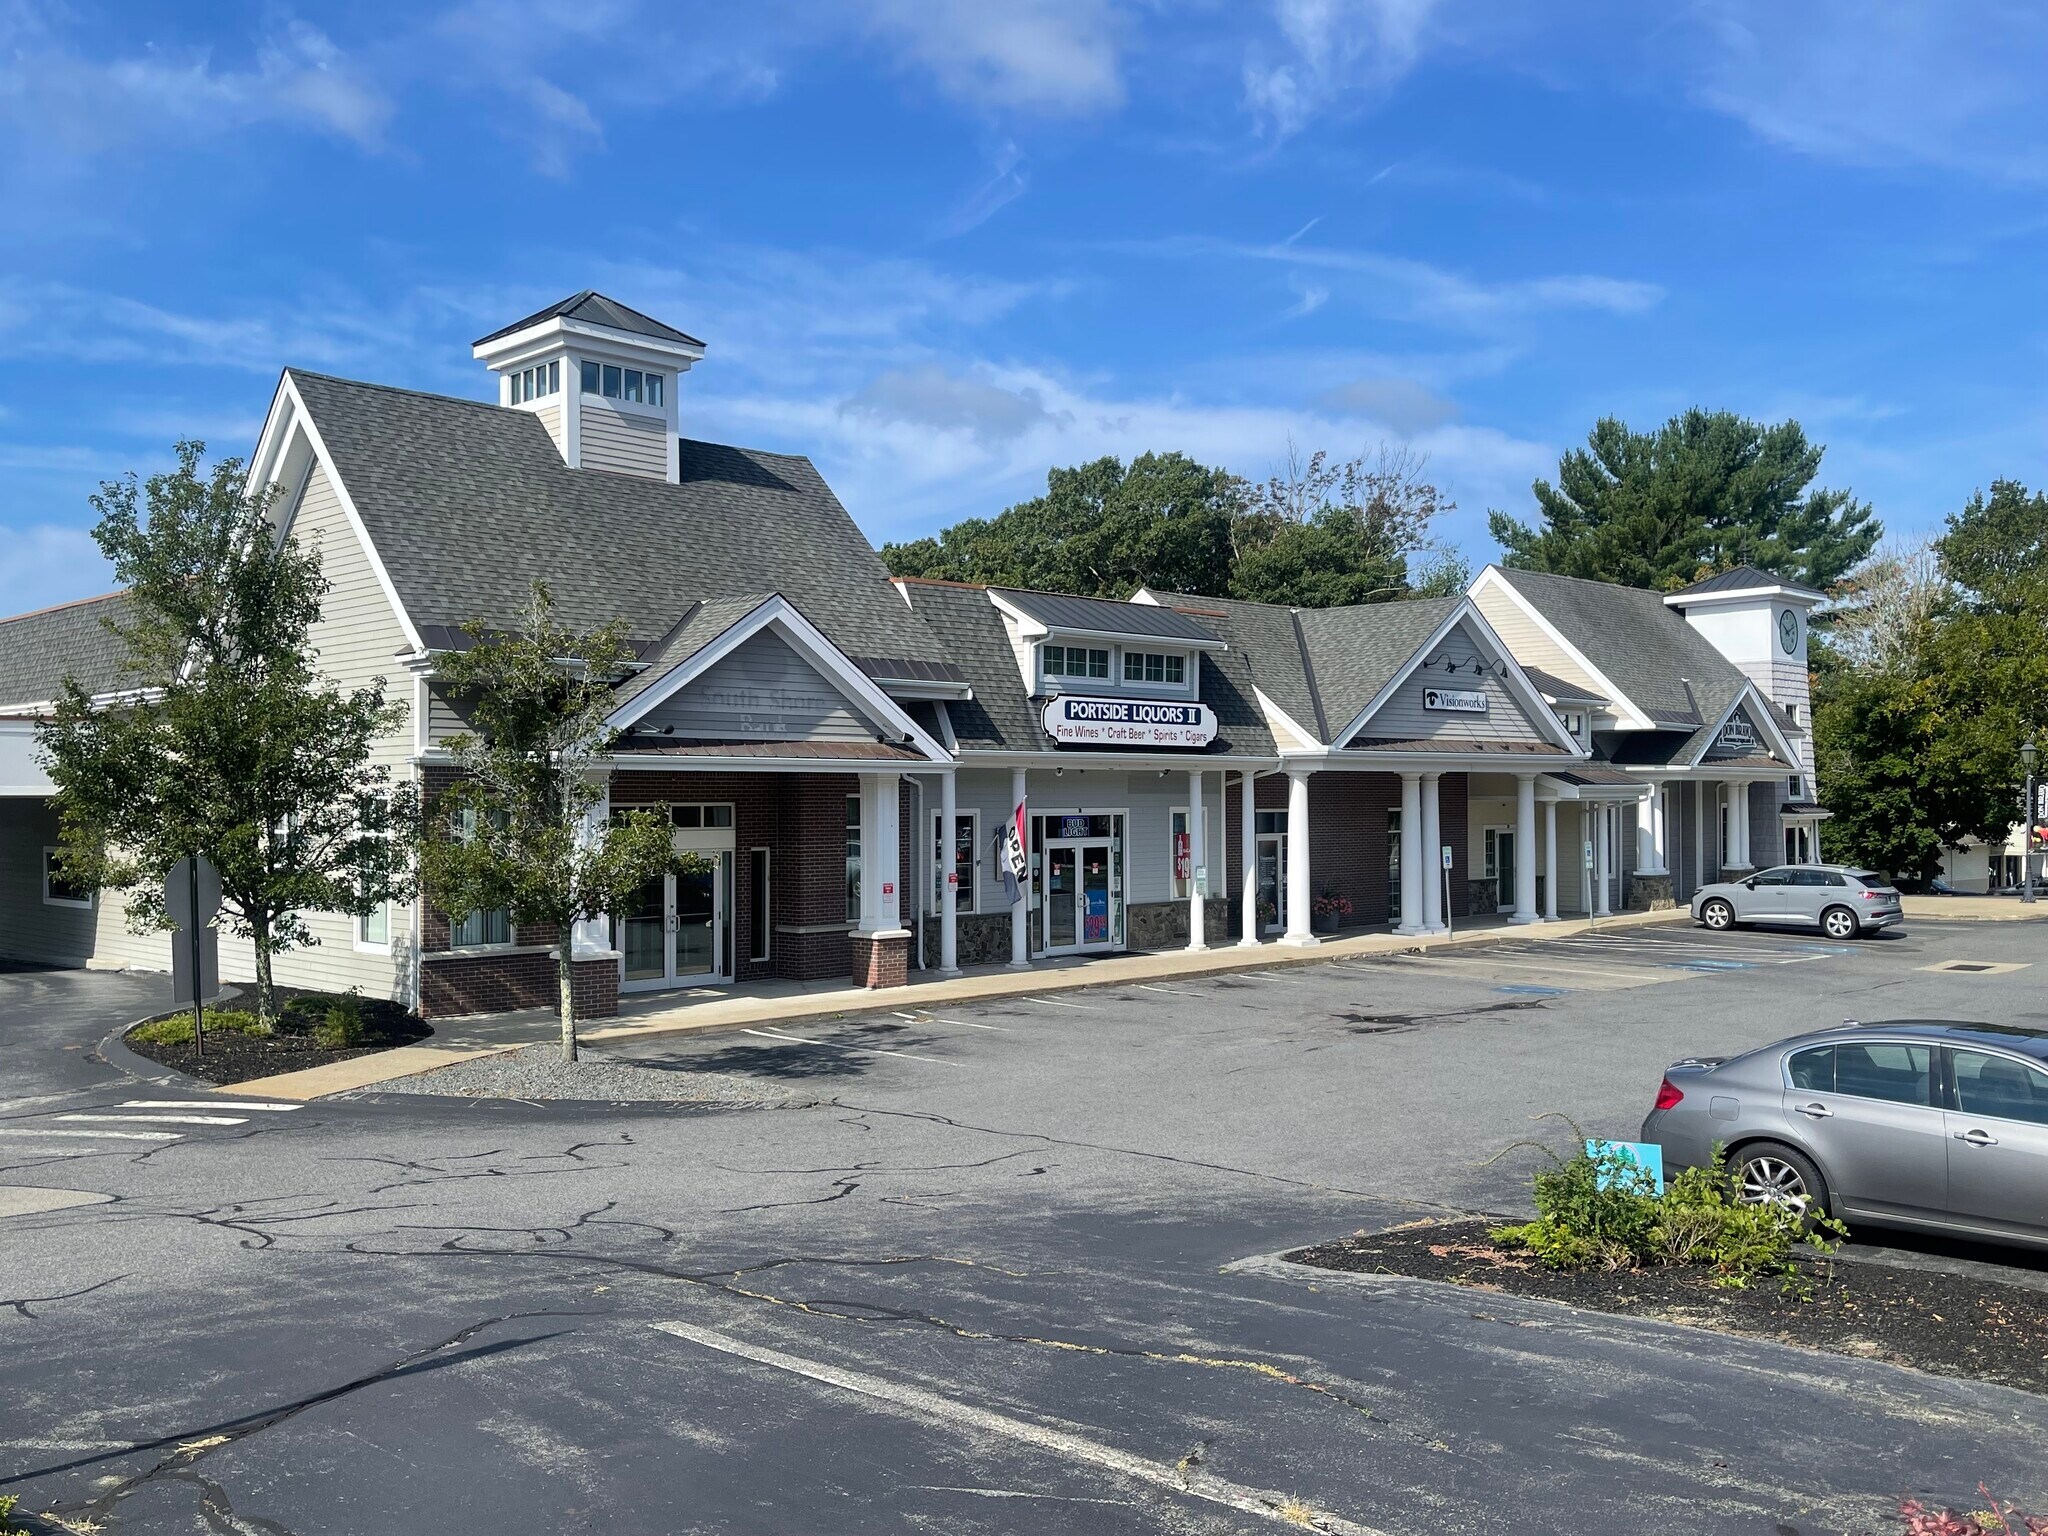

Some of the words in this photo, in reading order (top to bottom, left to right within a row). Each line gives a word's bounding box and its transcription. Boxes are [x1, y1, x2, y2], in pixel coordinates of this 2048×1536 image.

[1439, 693, 1485, 708] Visionworks
[1070, 702, 1129, 720] PORTSIDE
[1133, 705, 1184, 724] LIQUORS
[1187, 708, 1197, 724] II
[1056, 724, 1073, 738] Fine
[1074, 725, 1099, 738] Wines
[1107, 726, 1127, 739] Craft
[1128, 727, 1146, 740] Beer
[1154, 728, 1178, 743] Spirits
[1185, 730, 1208, 744] Cigars
[1067, 819, 1085, 828] BUD
[1063, 827, 1089, 838] LIGHT
[1008, 826, 1028, 883] OPEN
